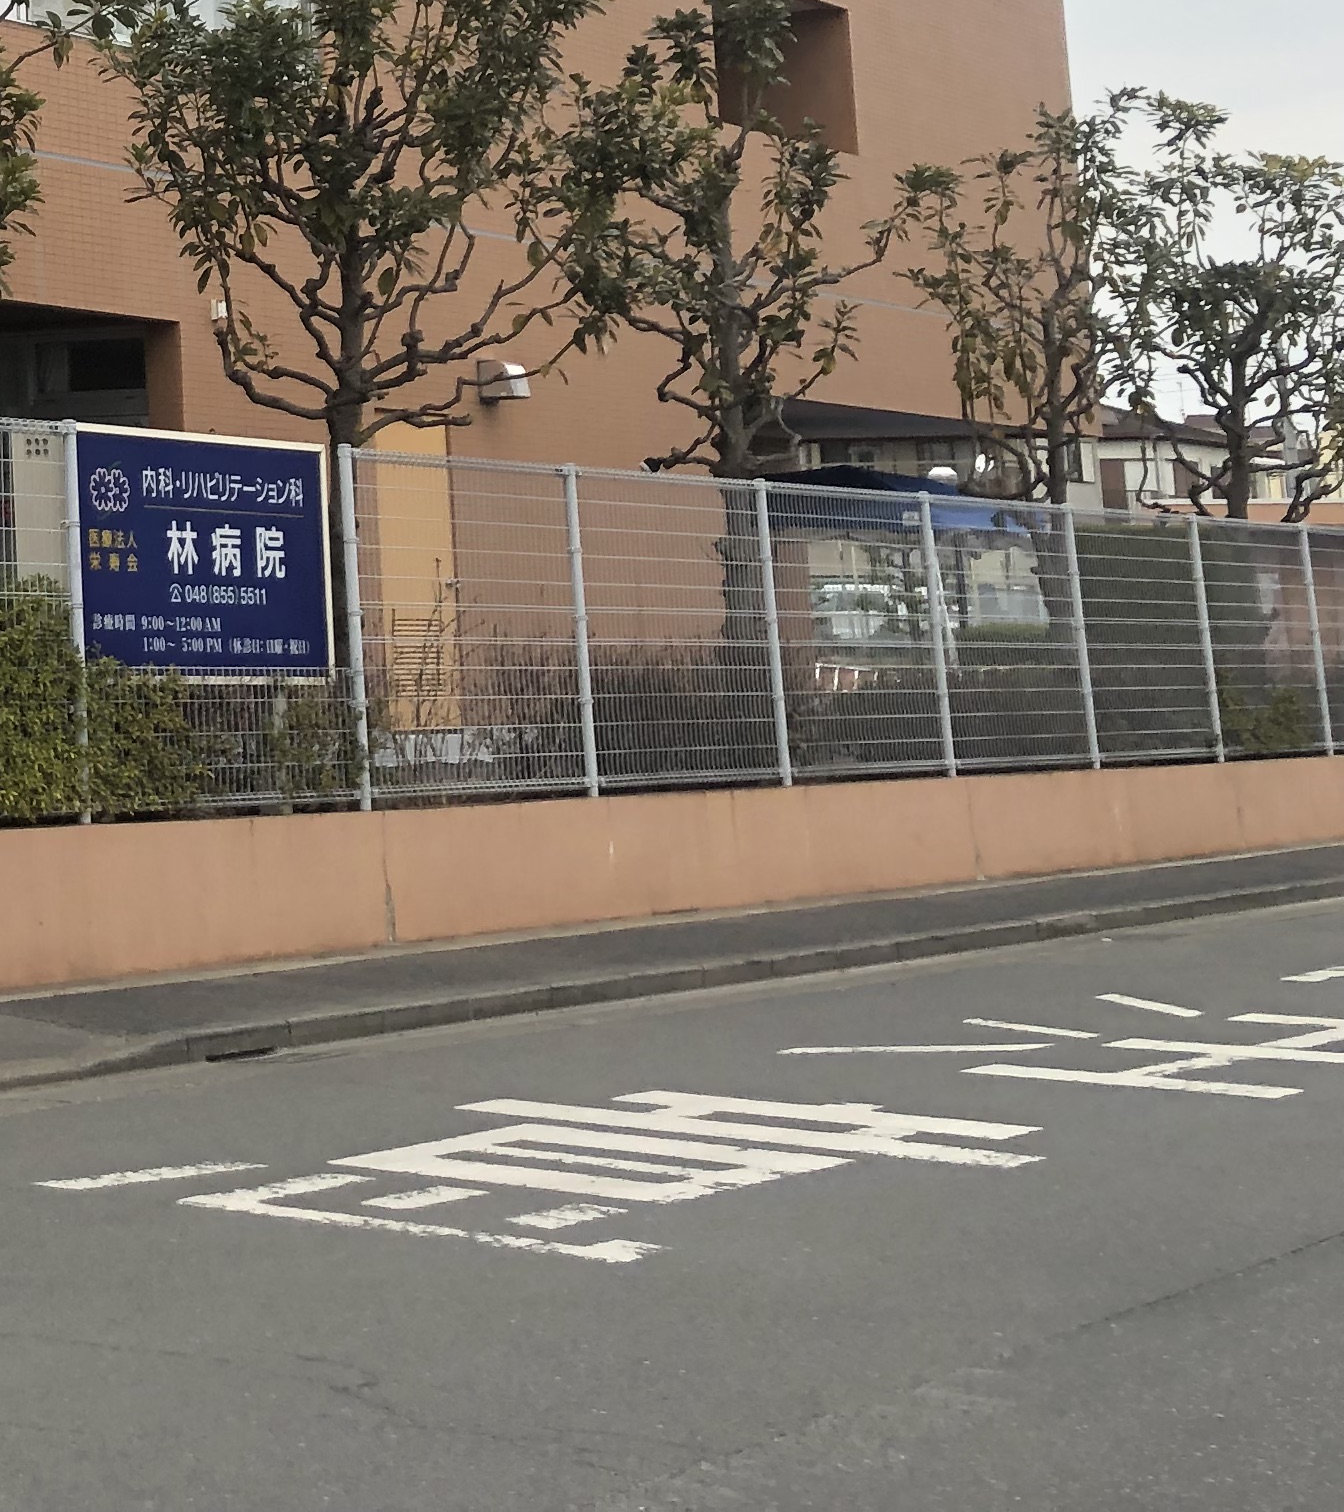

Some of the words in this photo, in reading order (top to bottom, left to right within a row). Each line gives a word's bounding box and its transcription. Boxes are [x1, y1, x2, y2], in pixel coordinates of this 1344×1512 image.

[141, 465, 304, 508] 内科・リハビリテーション科
[166, 520, 287, 579] 林病院
[92, 613, 136, 631] 診療時間
[204, 617, 222, 632] AM
[206, 638, 223, 654] PM
